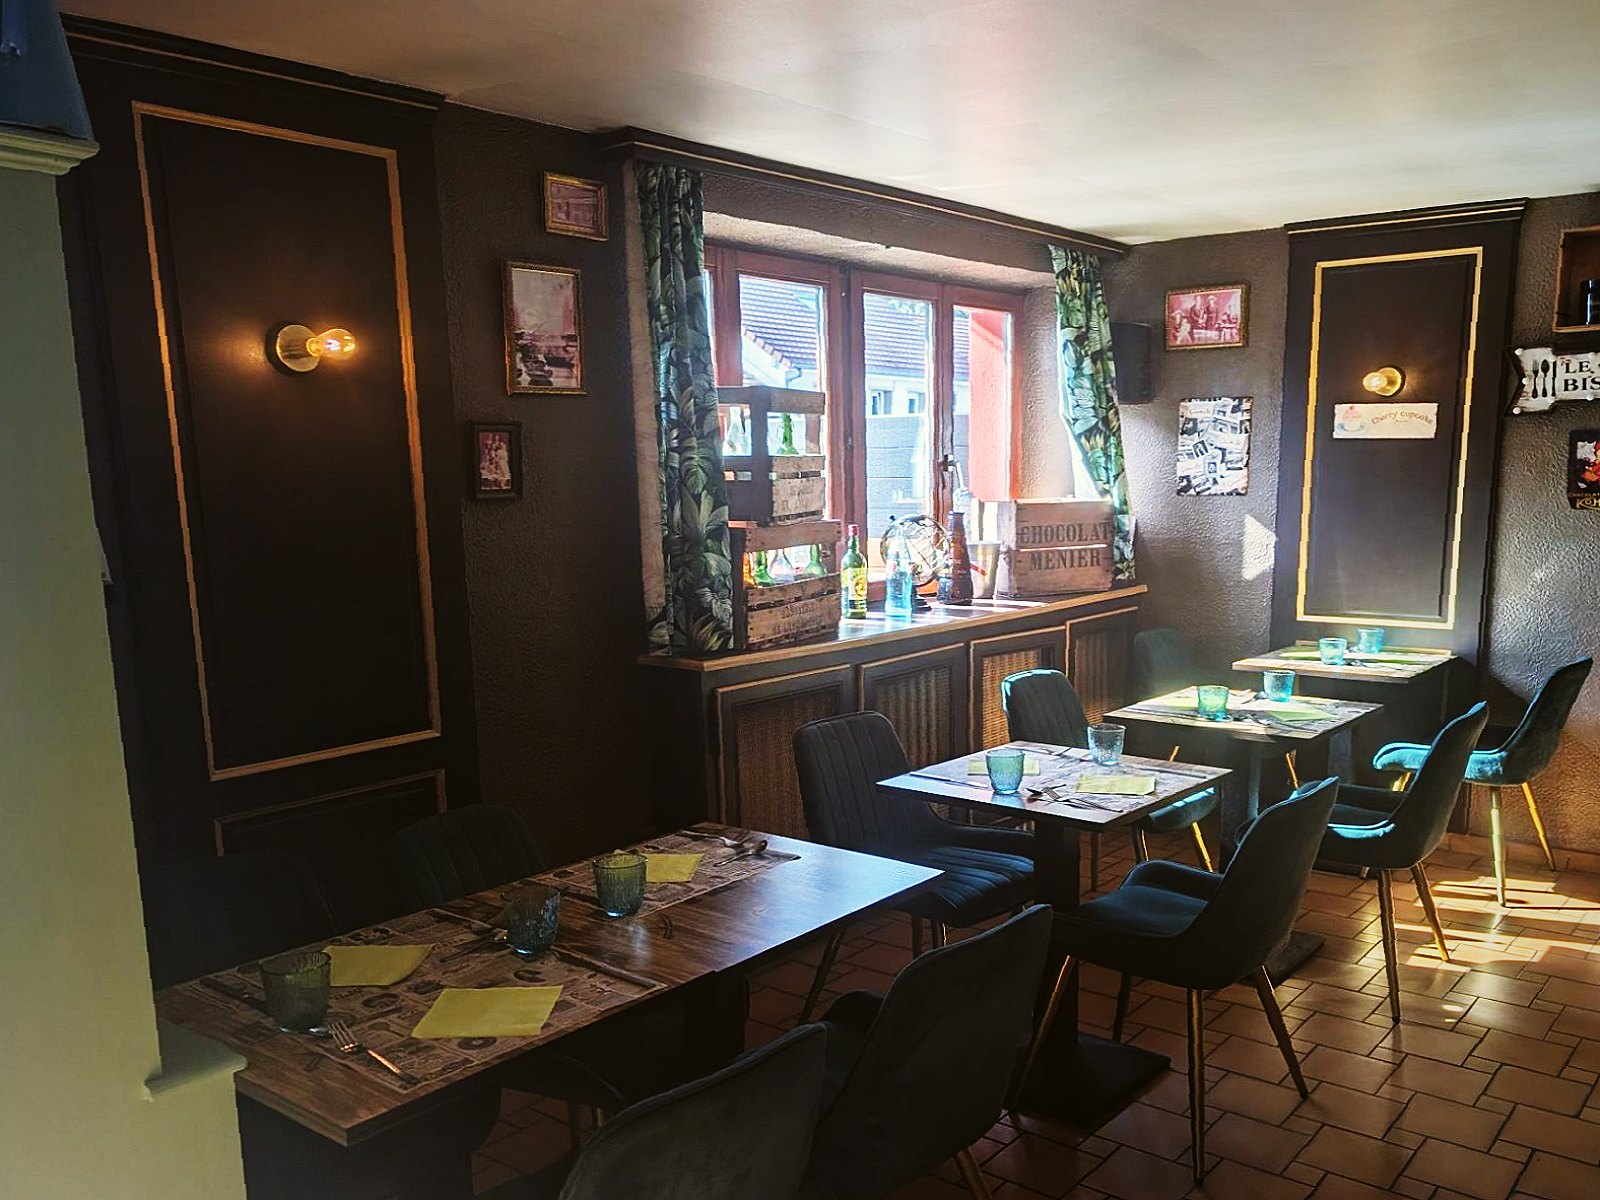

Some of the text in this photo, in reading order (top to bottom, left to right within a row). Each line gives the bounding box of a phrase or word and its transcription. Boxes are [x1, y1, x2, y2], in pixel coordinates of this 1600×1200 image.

[1565, 361, 1591, 373] LE
[1563, 377, 1600, 391] BIS
[1371, 411, 1398, 425] Cherry
[1020, 522, 1111, 543] CHOCOLAT
[1030, 549, 1101, 571] MENIER
